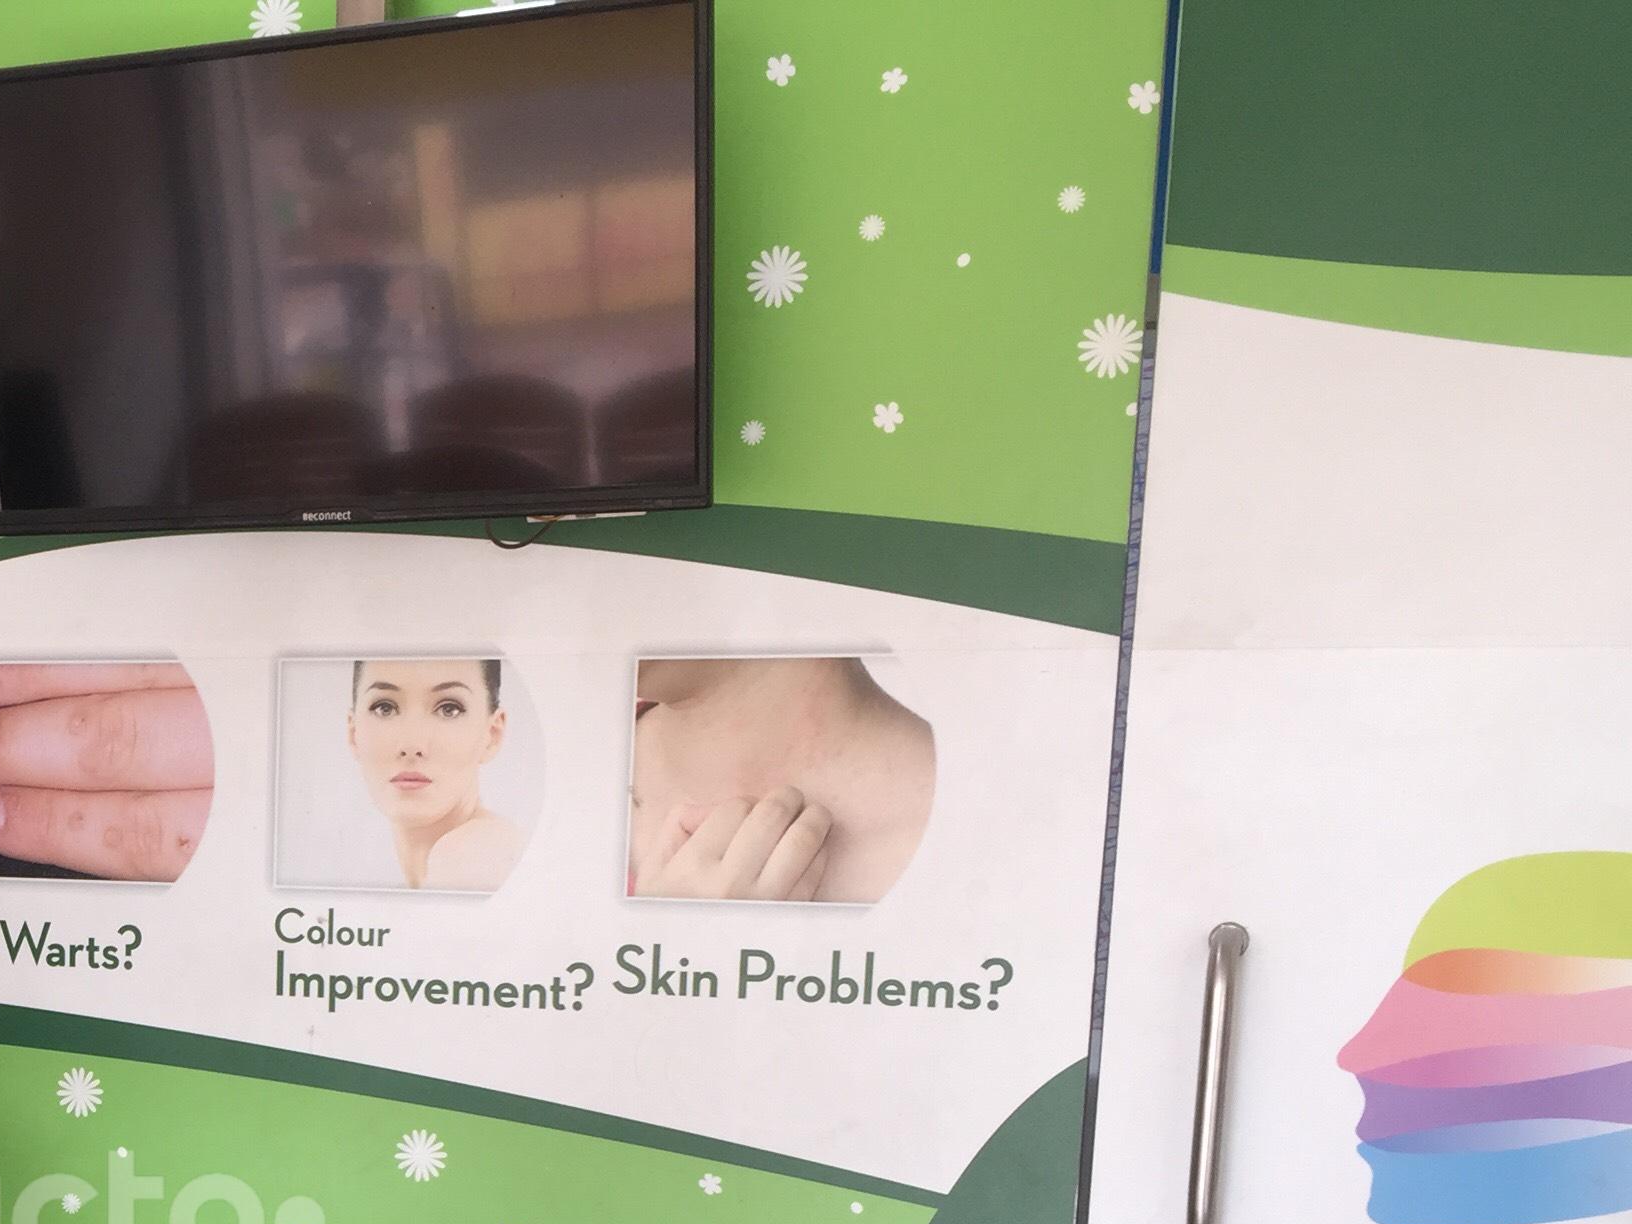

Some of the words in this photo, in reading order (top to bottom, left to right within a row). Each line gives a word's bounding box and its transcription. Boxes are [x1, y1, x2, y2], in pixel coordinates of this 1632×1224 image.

[0, 919, 142, 970] Warts?
[274, 907, 391, 948] Colour
[276, 949, 595, 1013] Improvement?
[612, 943, 718, 998] Skin
[738, 948, 1014, 1011] Problems?
